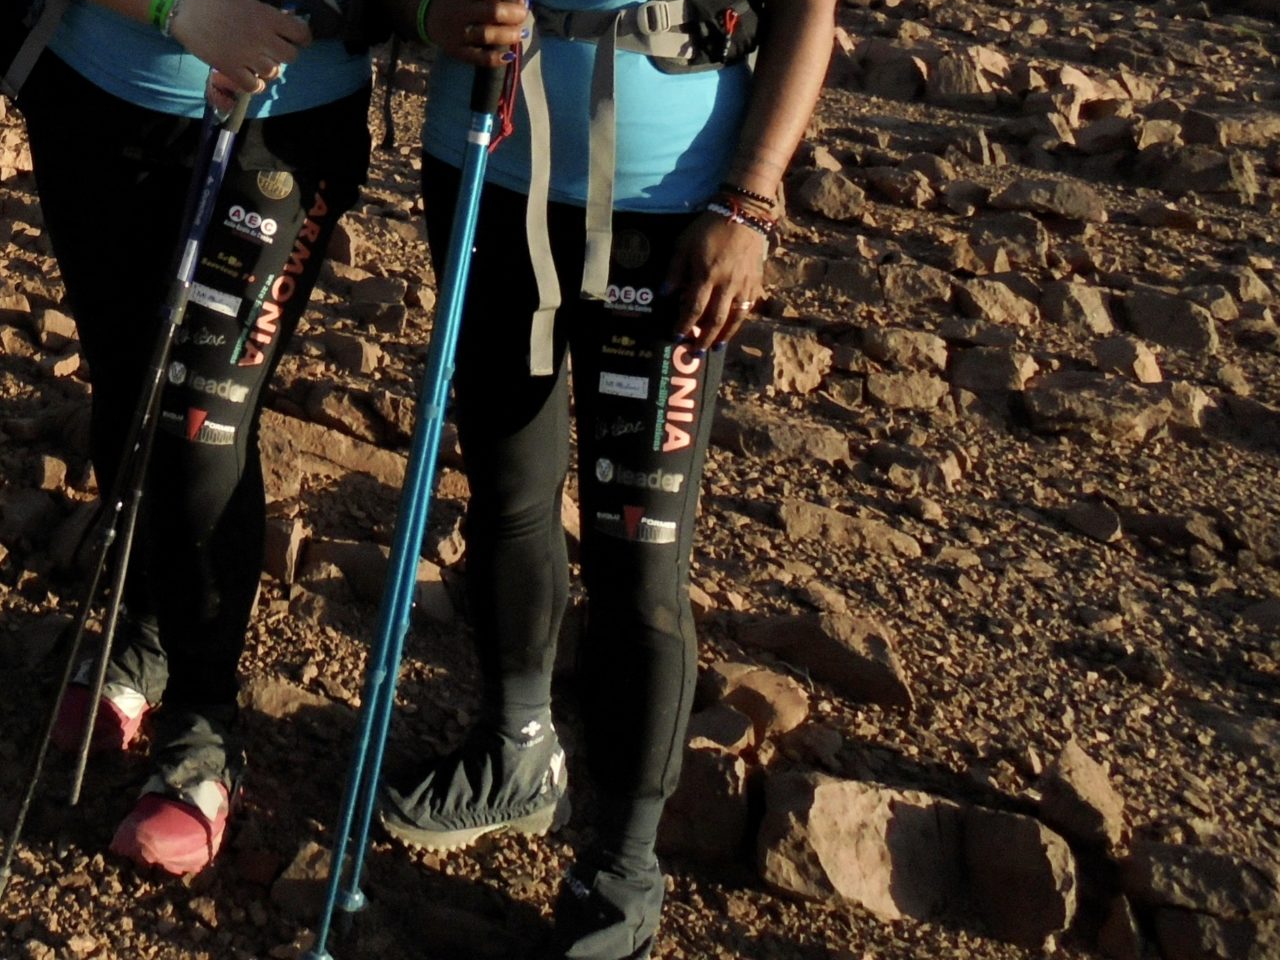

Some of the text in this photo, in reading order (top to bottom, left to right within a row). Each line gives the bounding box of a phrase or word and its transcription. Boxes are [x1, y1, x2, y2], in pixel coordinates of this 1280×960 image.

[230, 207, 276, 233] AEC
[238, 192, 328, 367] ARMONIA
[608, 287, 651, 303] AEC
[187, 371, 249, 403] leader
[653, 345, 672, 452] we are facility solutions
[616, 464, 684, 493] leader
